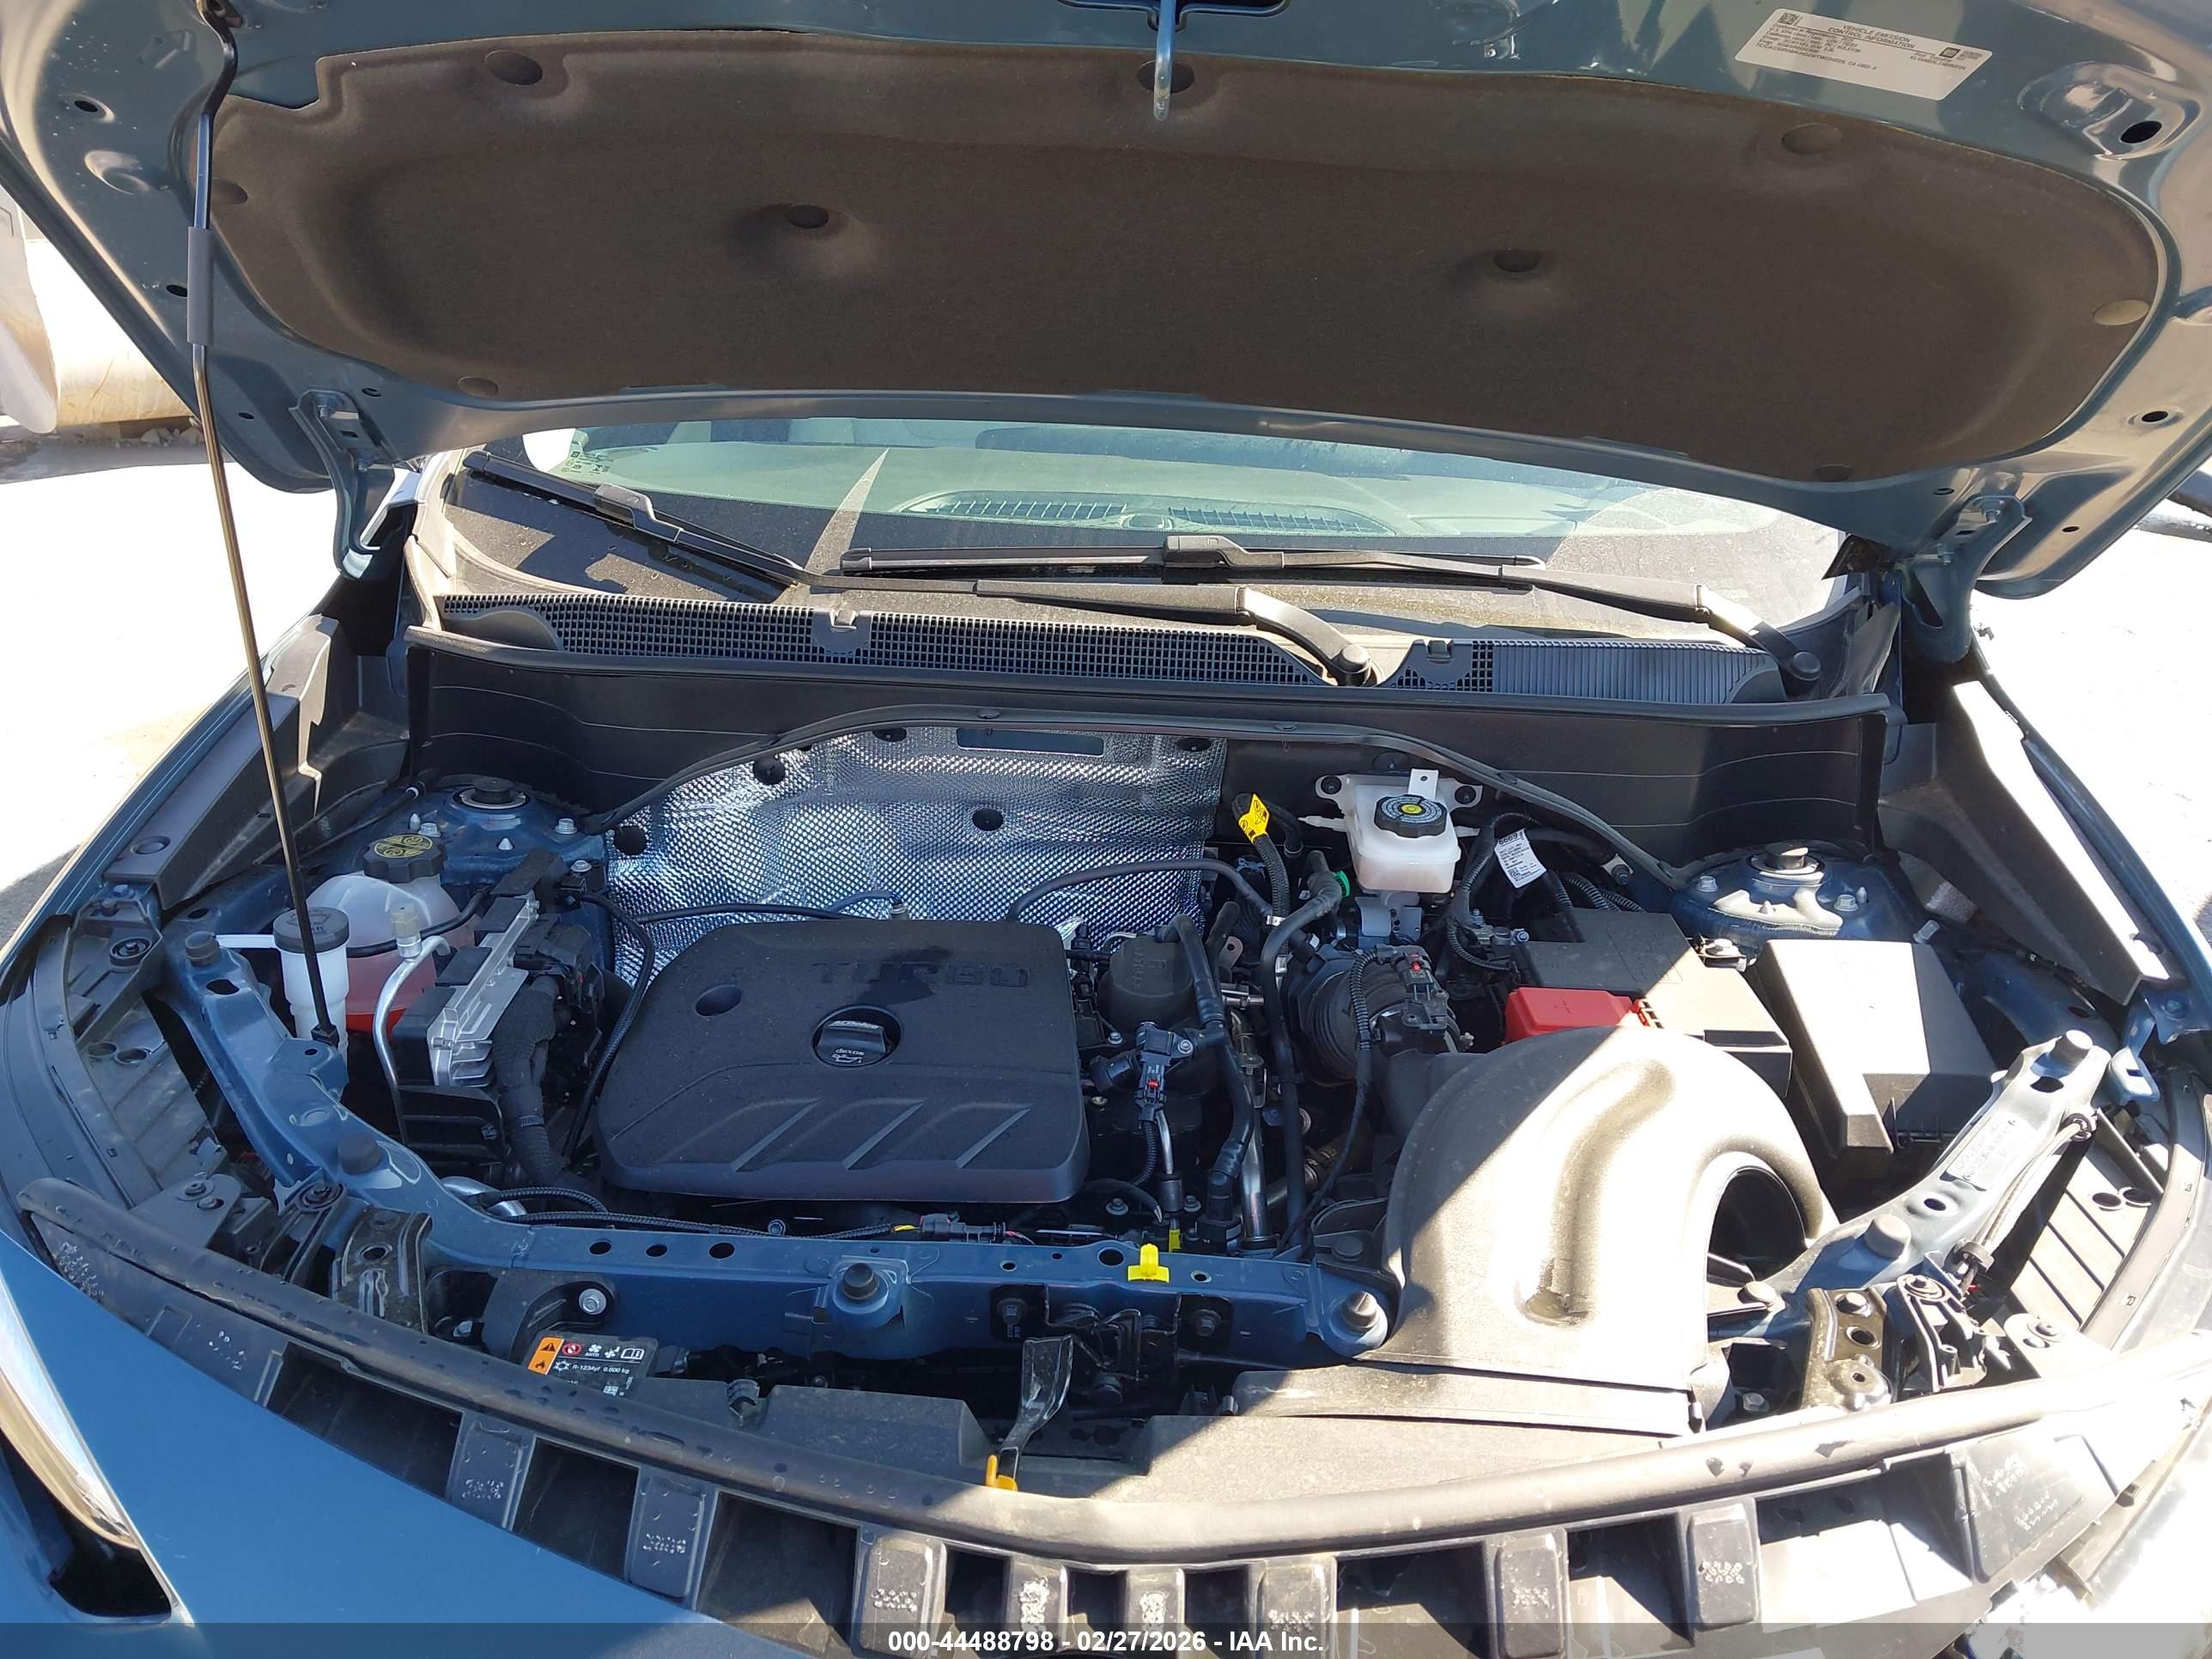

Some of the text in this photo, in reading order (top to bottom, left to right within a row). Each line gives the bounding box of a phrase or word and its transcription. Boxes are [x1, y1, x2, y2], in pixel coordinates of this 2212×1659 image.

[1828, 27, 1862, 39] CONTROL
[1863, 34, 1916, 49] INFORMATION
[1842, 25, 1911, 43] VEHICLE EMISSION
[812, 960, 1030, 988] TURBO
[836, 1048, 865, 1056] dexos
